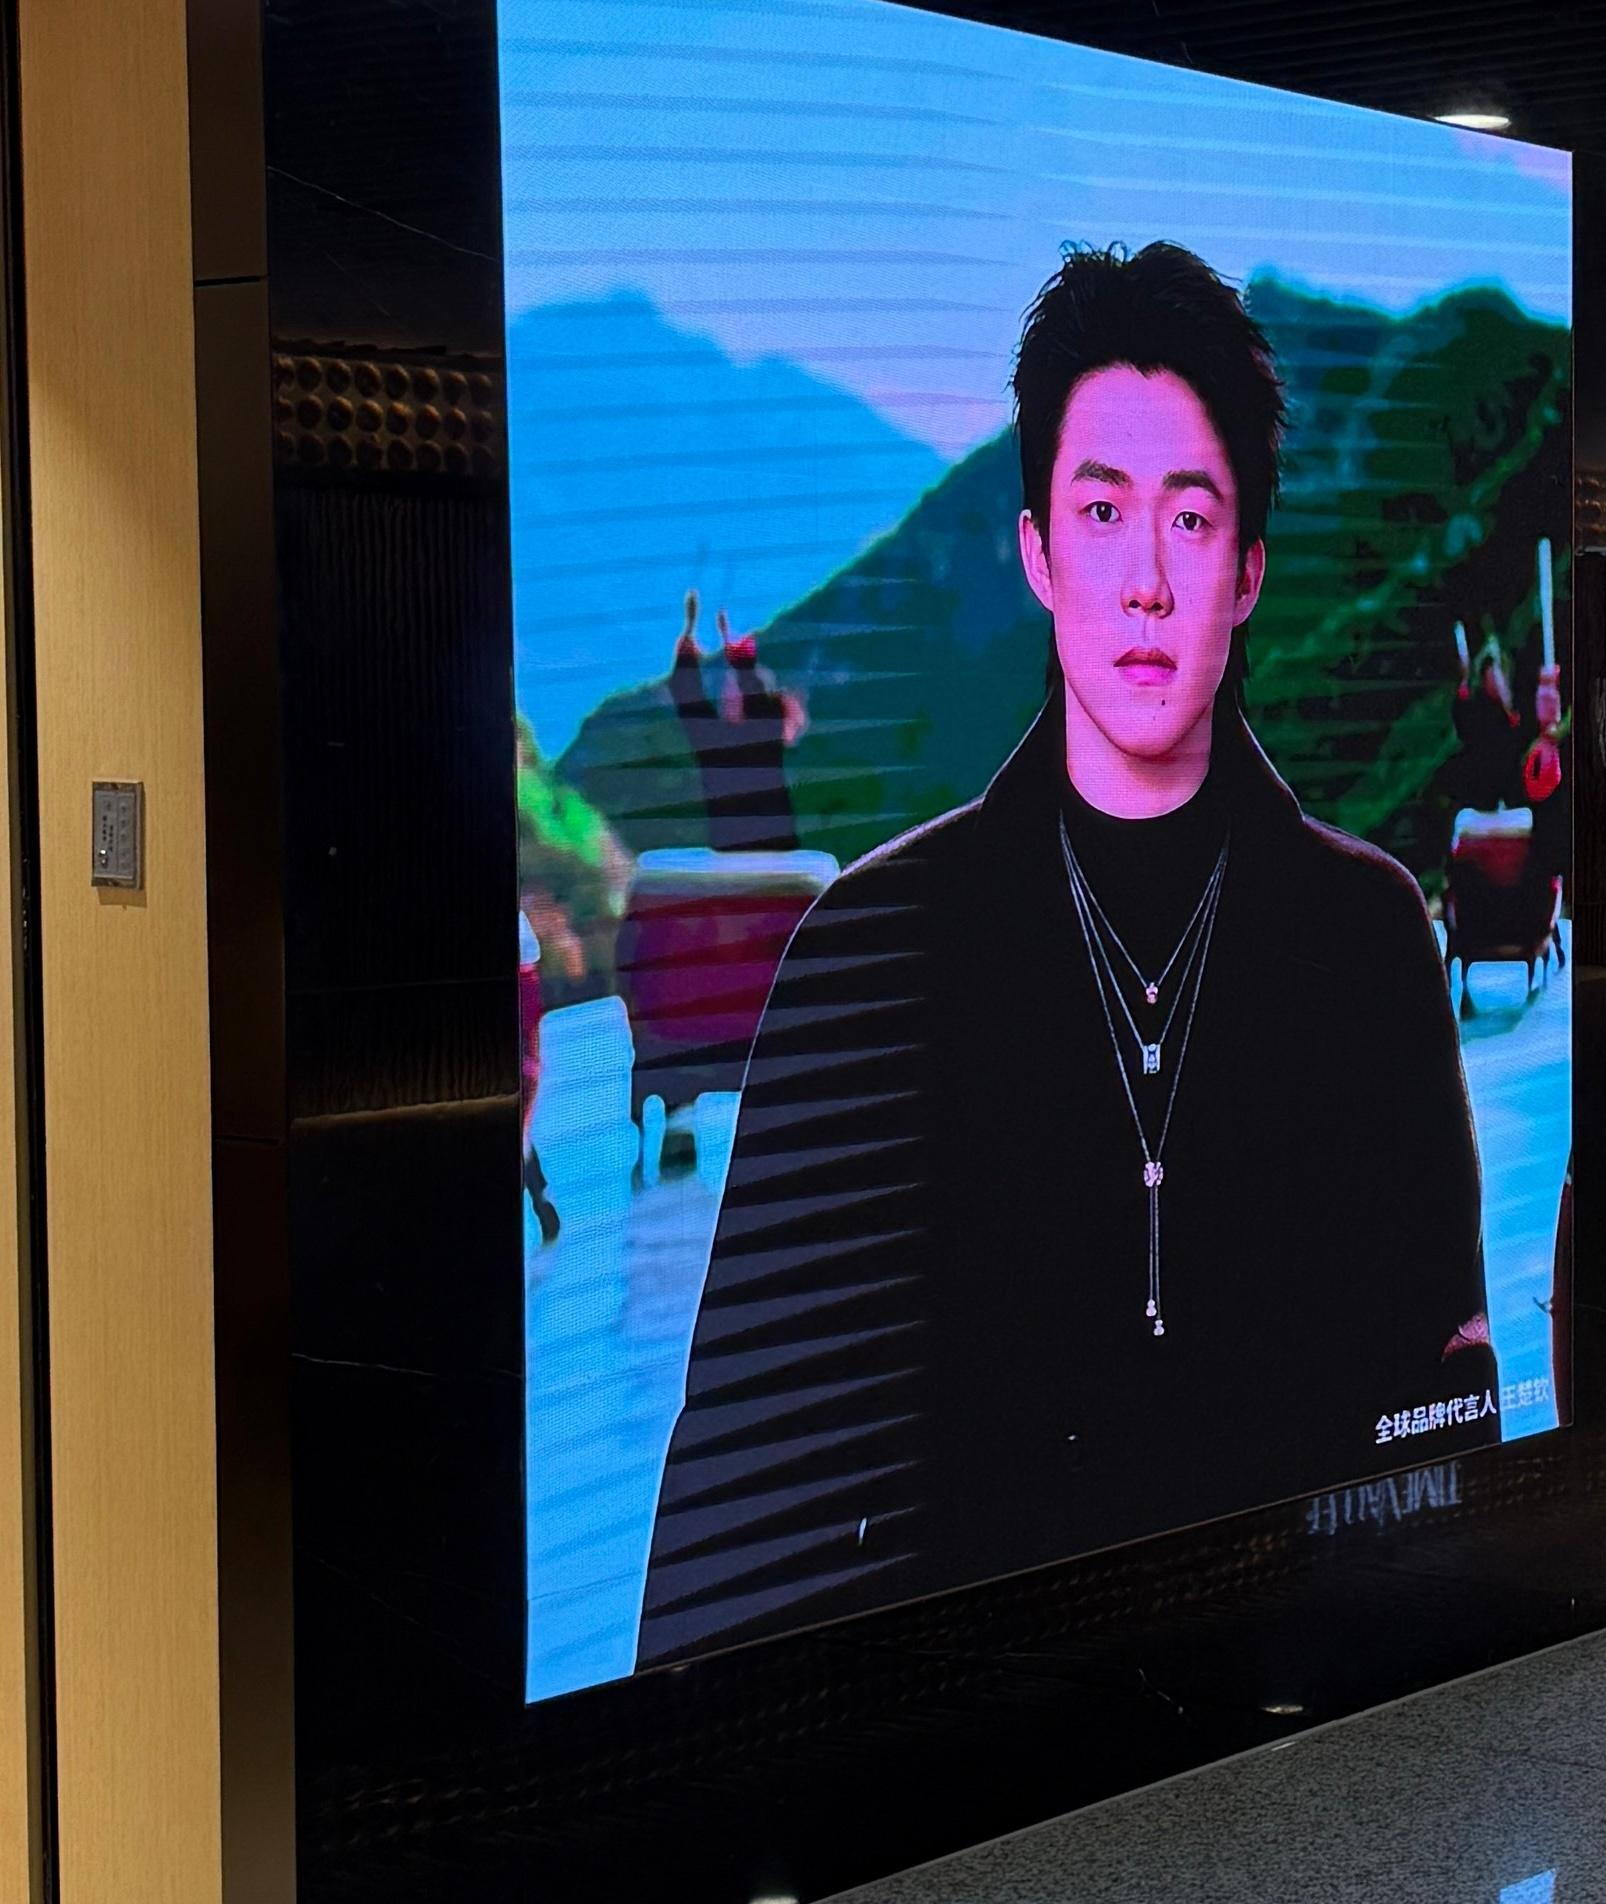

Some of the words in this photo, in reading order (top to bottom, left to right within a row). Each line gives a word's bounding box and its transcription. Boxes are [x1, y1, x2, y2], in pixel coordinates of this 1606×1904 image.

[1374, 1389, 1498, 1445] 全球品牌代言人
